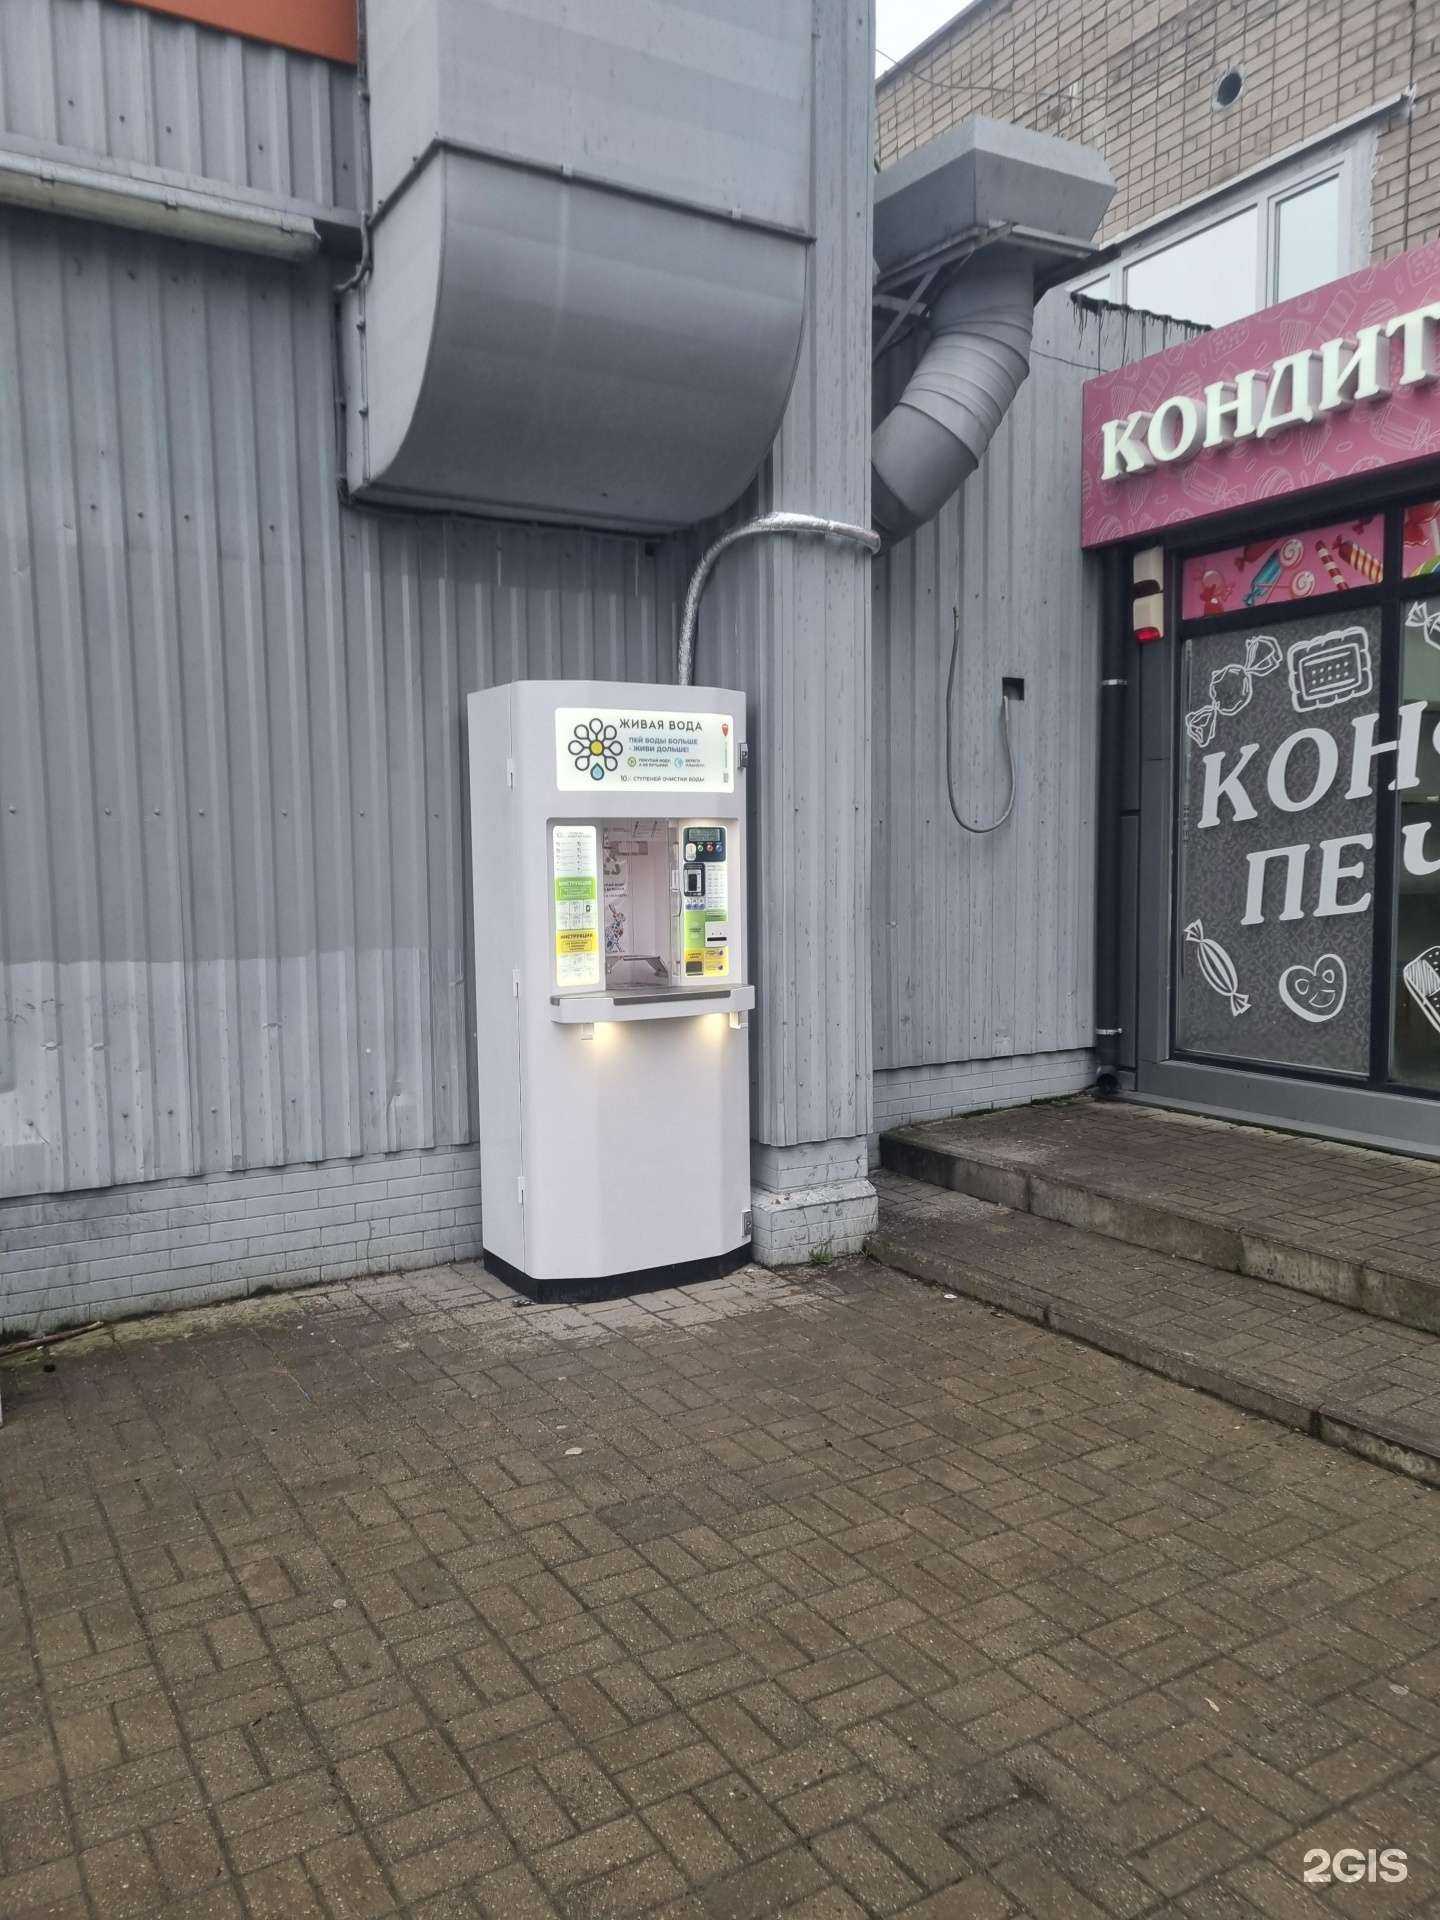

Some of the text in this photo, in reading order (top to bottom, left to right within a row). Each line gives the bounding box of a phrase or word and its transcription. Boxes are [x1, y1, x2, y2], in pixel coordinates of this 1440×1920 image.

[1101, 301, 1440, 480] КОНДИТ
[619, 718, 703, 733] ЖИВАЯ ВОДА
[645, 737, 667, 745] ВОДЫ
[1197, 700, 1440, 828] КОН
